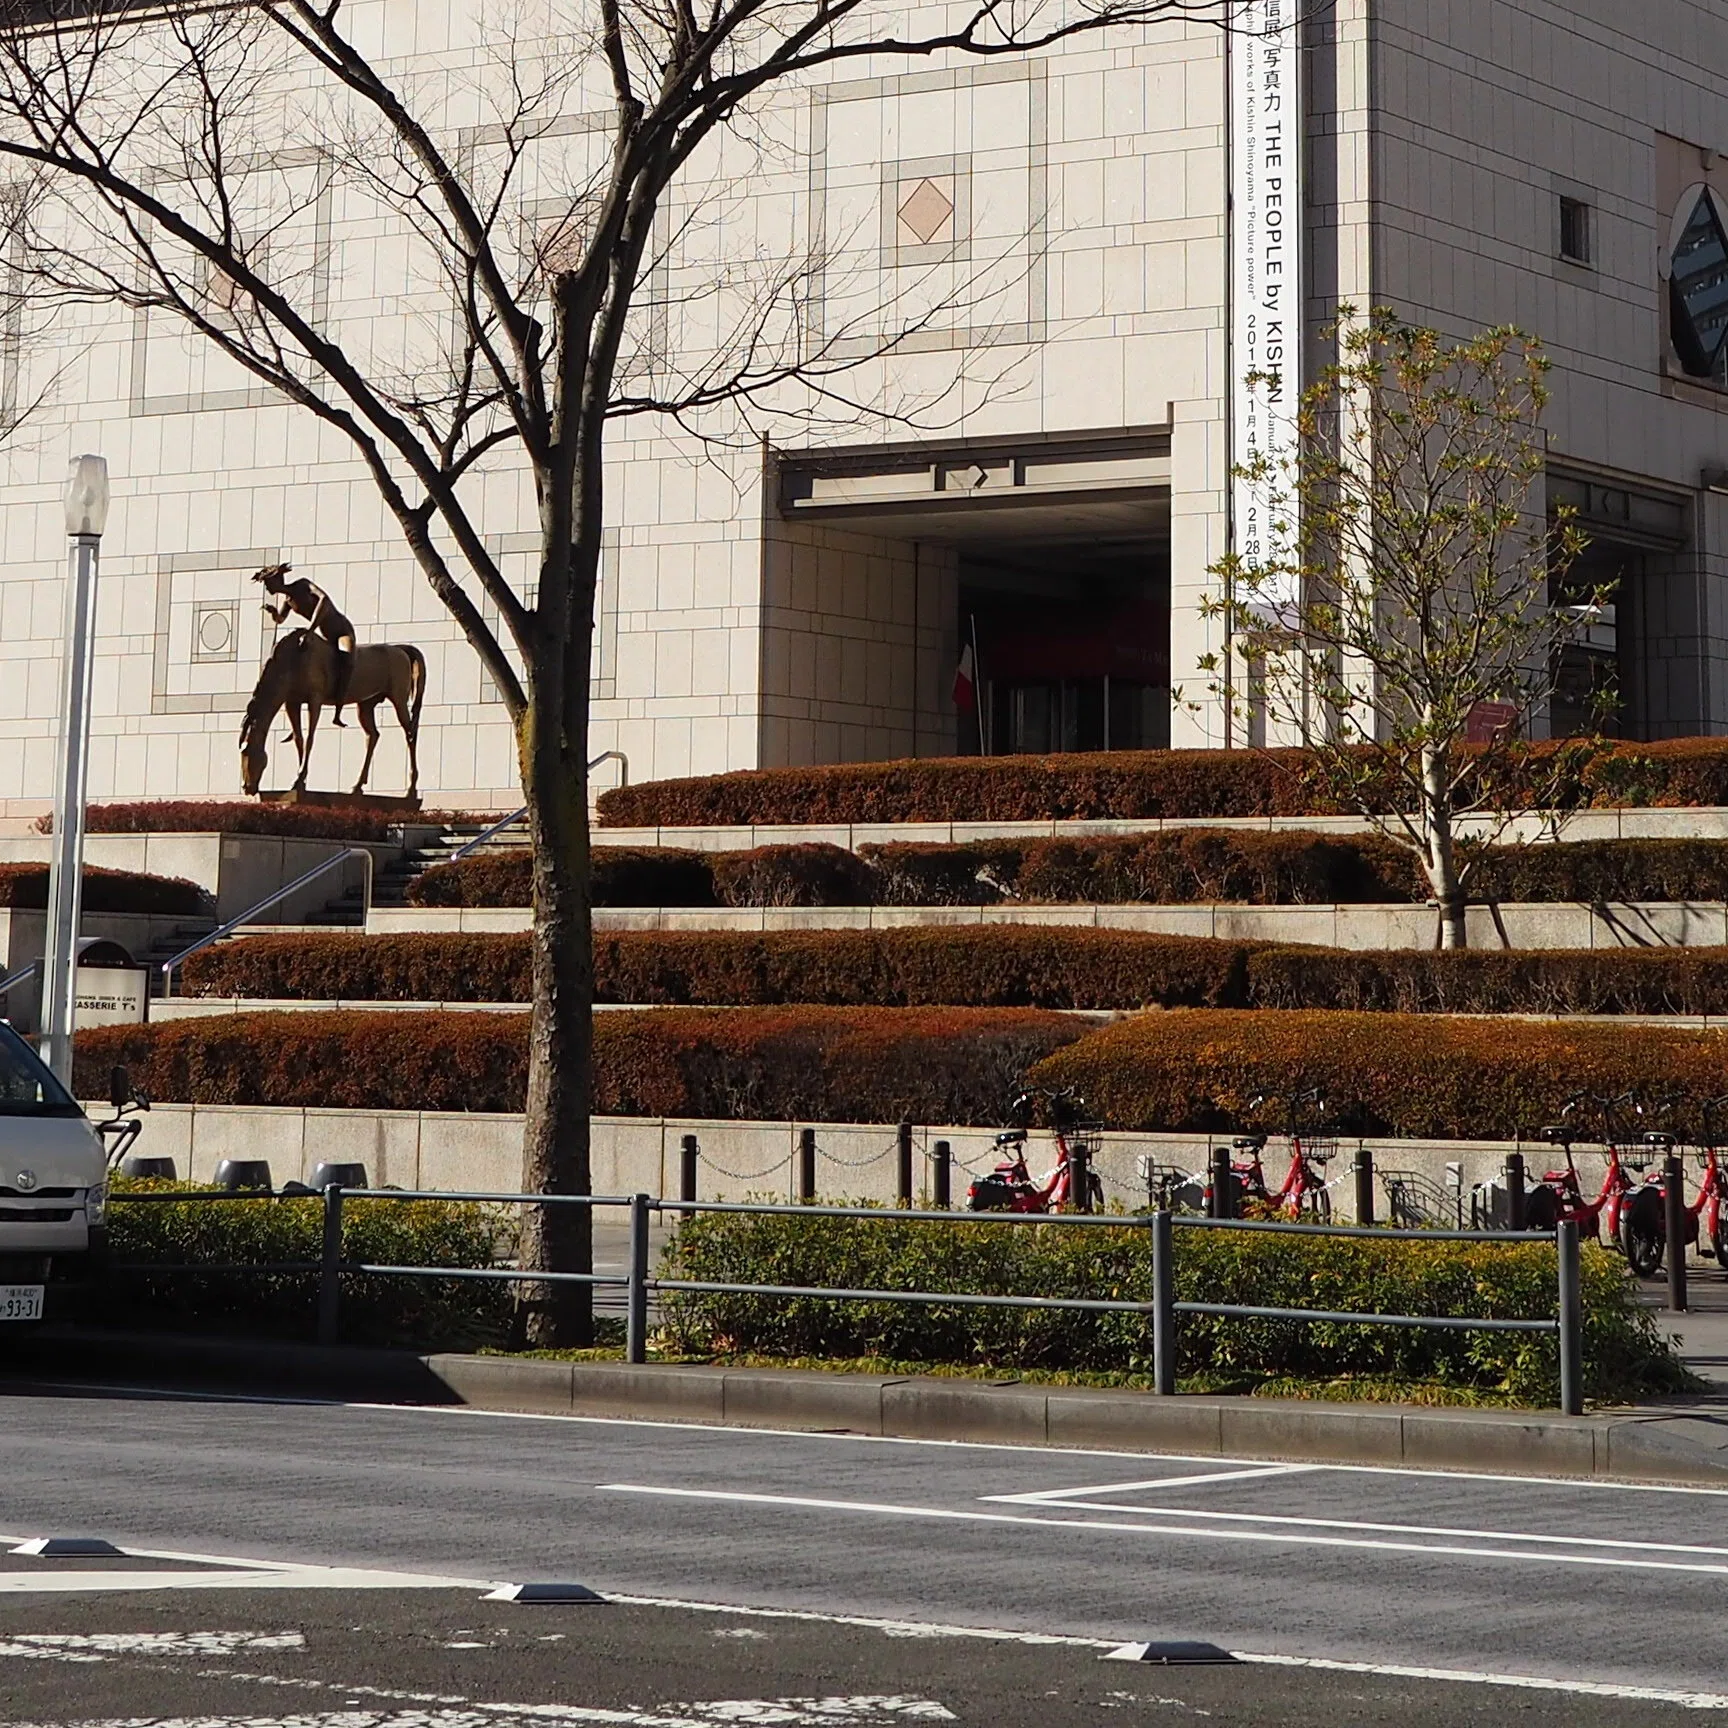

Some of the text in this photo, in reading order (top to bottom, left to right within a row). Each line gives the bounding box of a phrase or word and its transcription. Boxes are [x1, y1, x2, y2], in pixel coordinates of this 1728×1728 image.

[1246, 42, 1255, 77] works
[1262, 48, 1282, 112] 写真力
[1246, 81, 1256, 92] of
[1246, 97, 1256, 133] Kishin
[1265, 120, 1282, 168] THE
[1245, 137, 1256, 202] Shinoyama
[1265, 177, 1283, 276] PEOPLE
[1262, 285, 1283, 312] by
